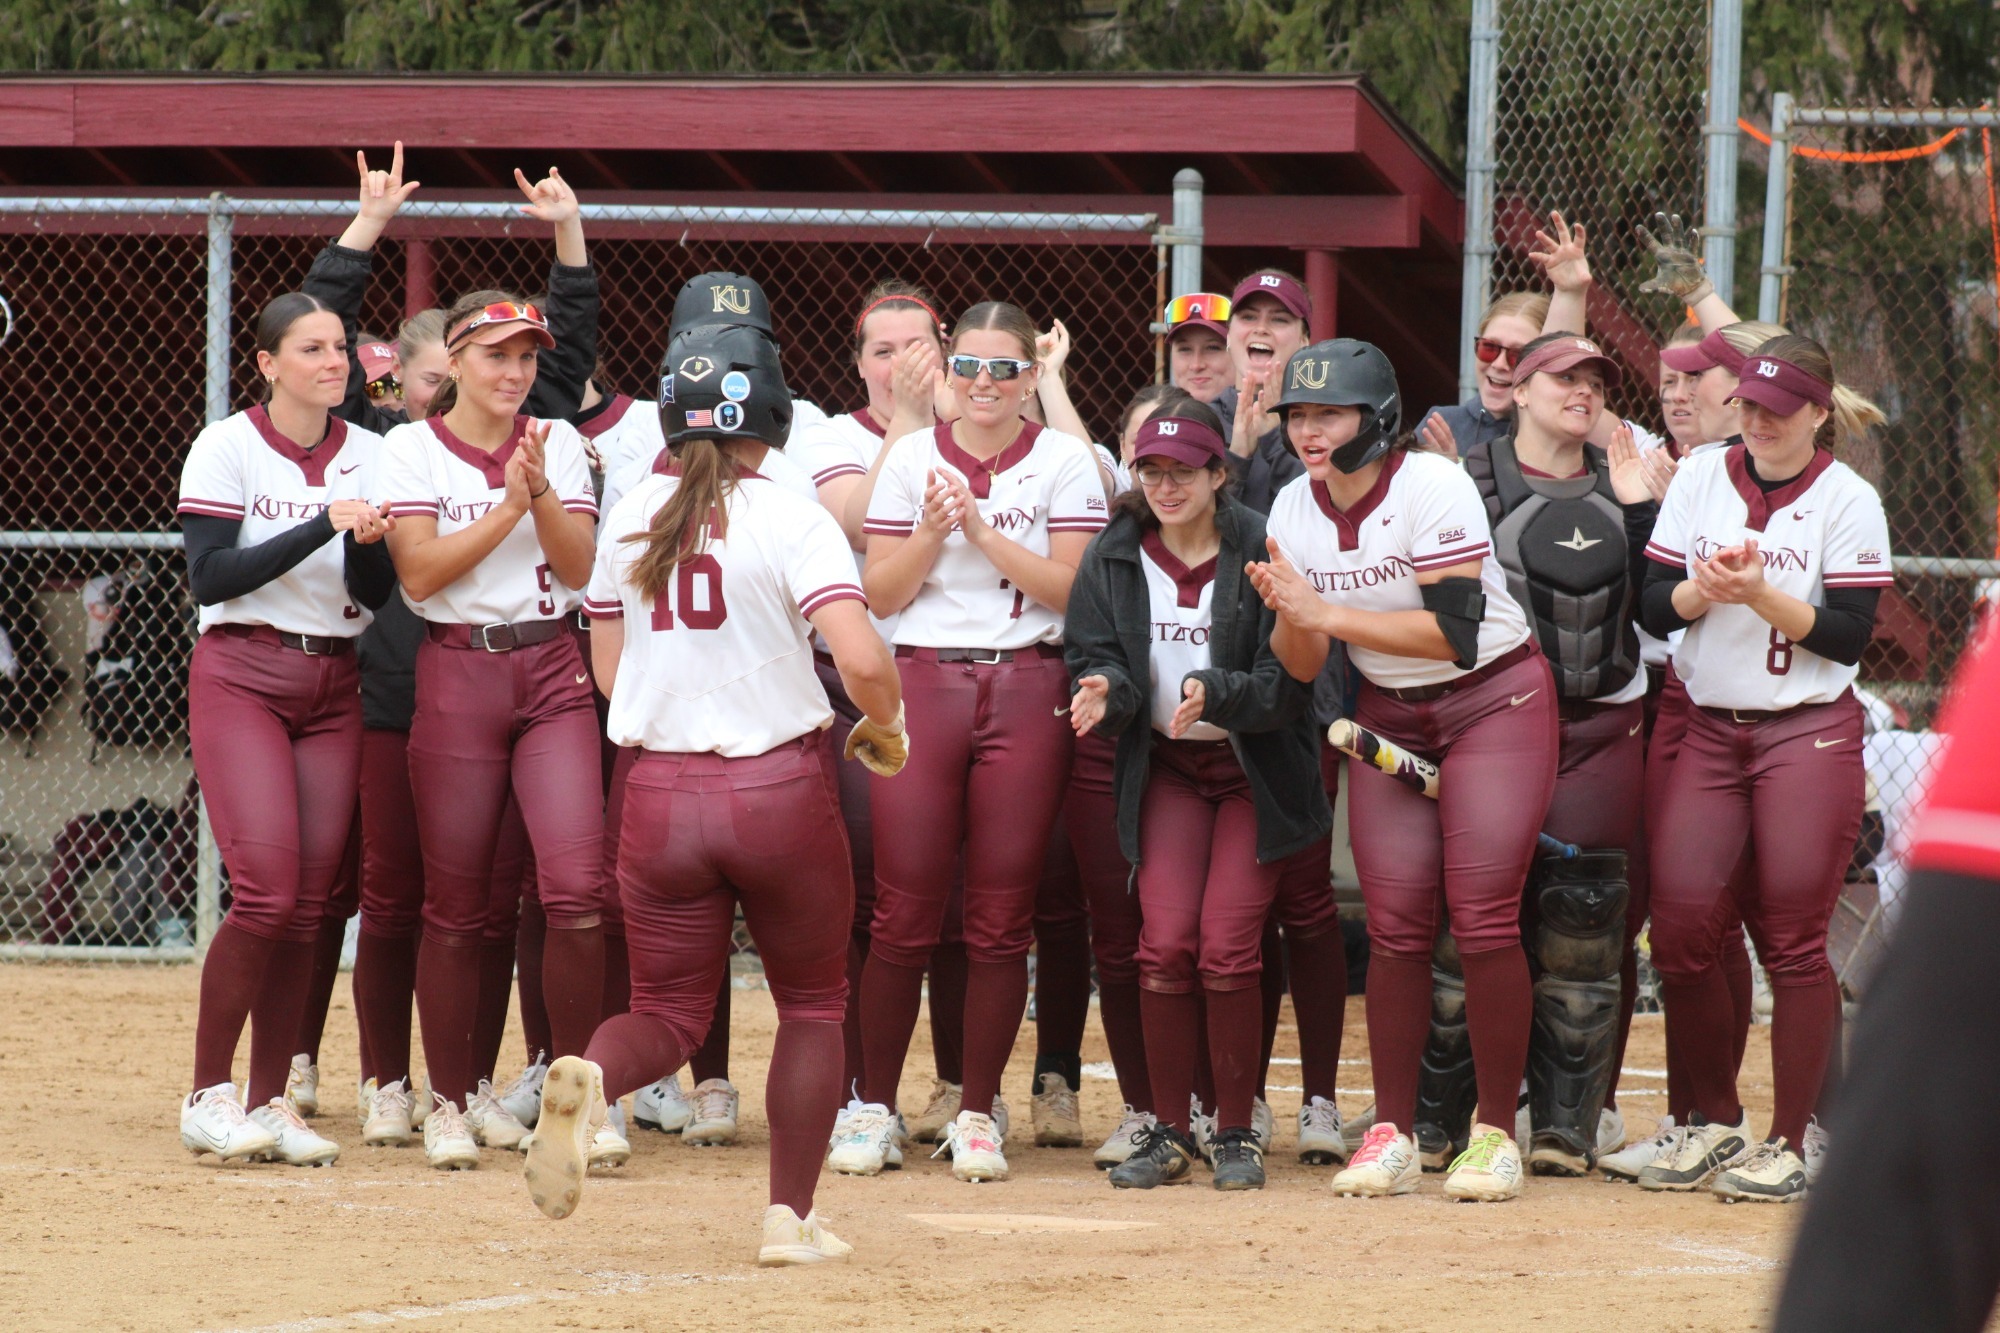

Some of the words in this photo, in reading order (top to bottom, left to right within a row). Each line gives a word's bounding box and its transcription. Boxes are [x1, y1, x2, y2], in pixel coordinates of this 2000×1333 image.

[1259, 275, 1281, 287] KU
[709, 285, 750, 315] KU
[371, 345, 392, 358] KU
[1575, 339, 1595, 353] KU
[1291, 358, 1331, 389] KU
[1757, 360, 1779, 378] KU
[1157, 421, 1179, 436] KU
[251, 494, 327, 520] KUTZT
[1438, 527, 1466, 541] PSAC
[1857, 552, 1881, 561] PSAC
